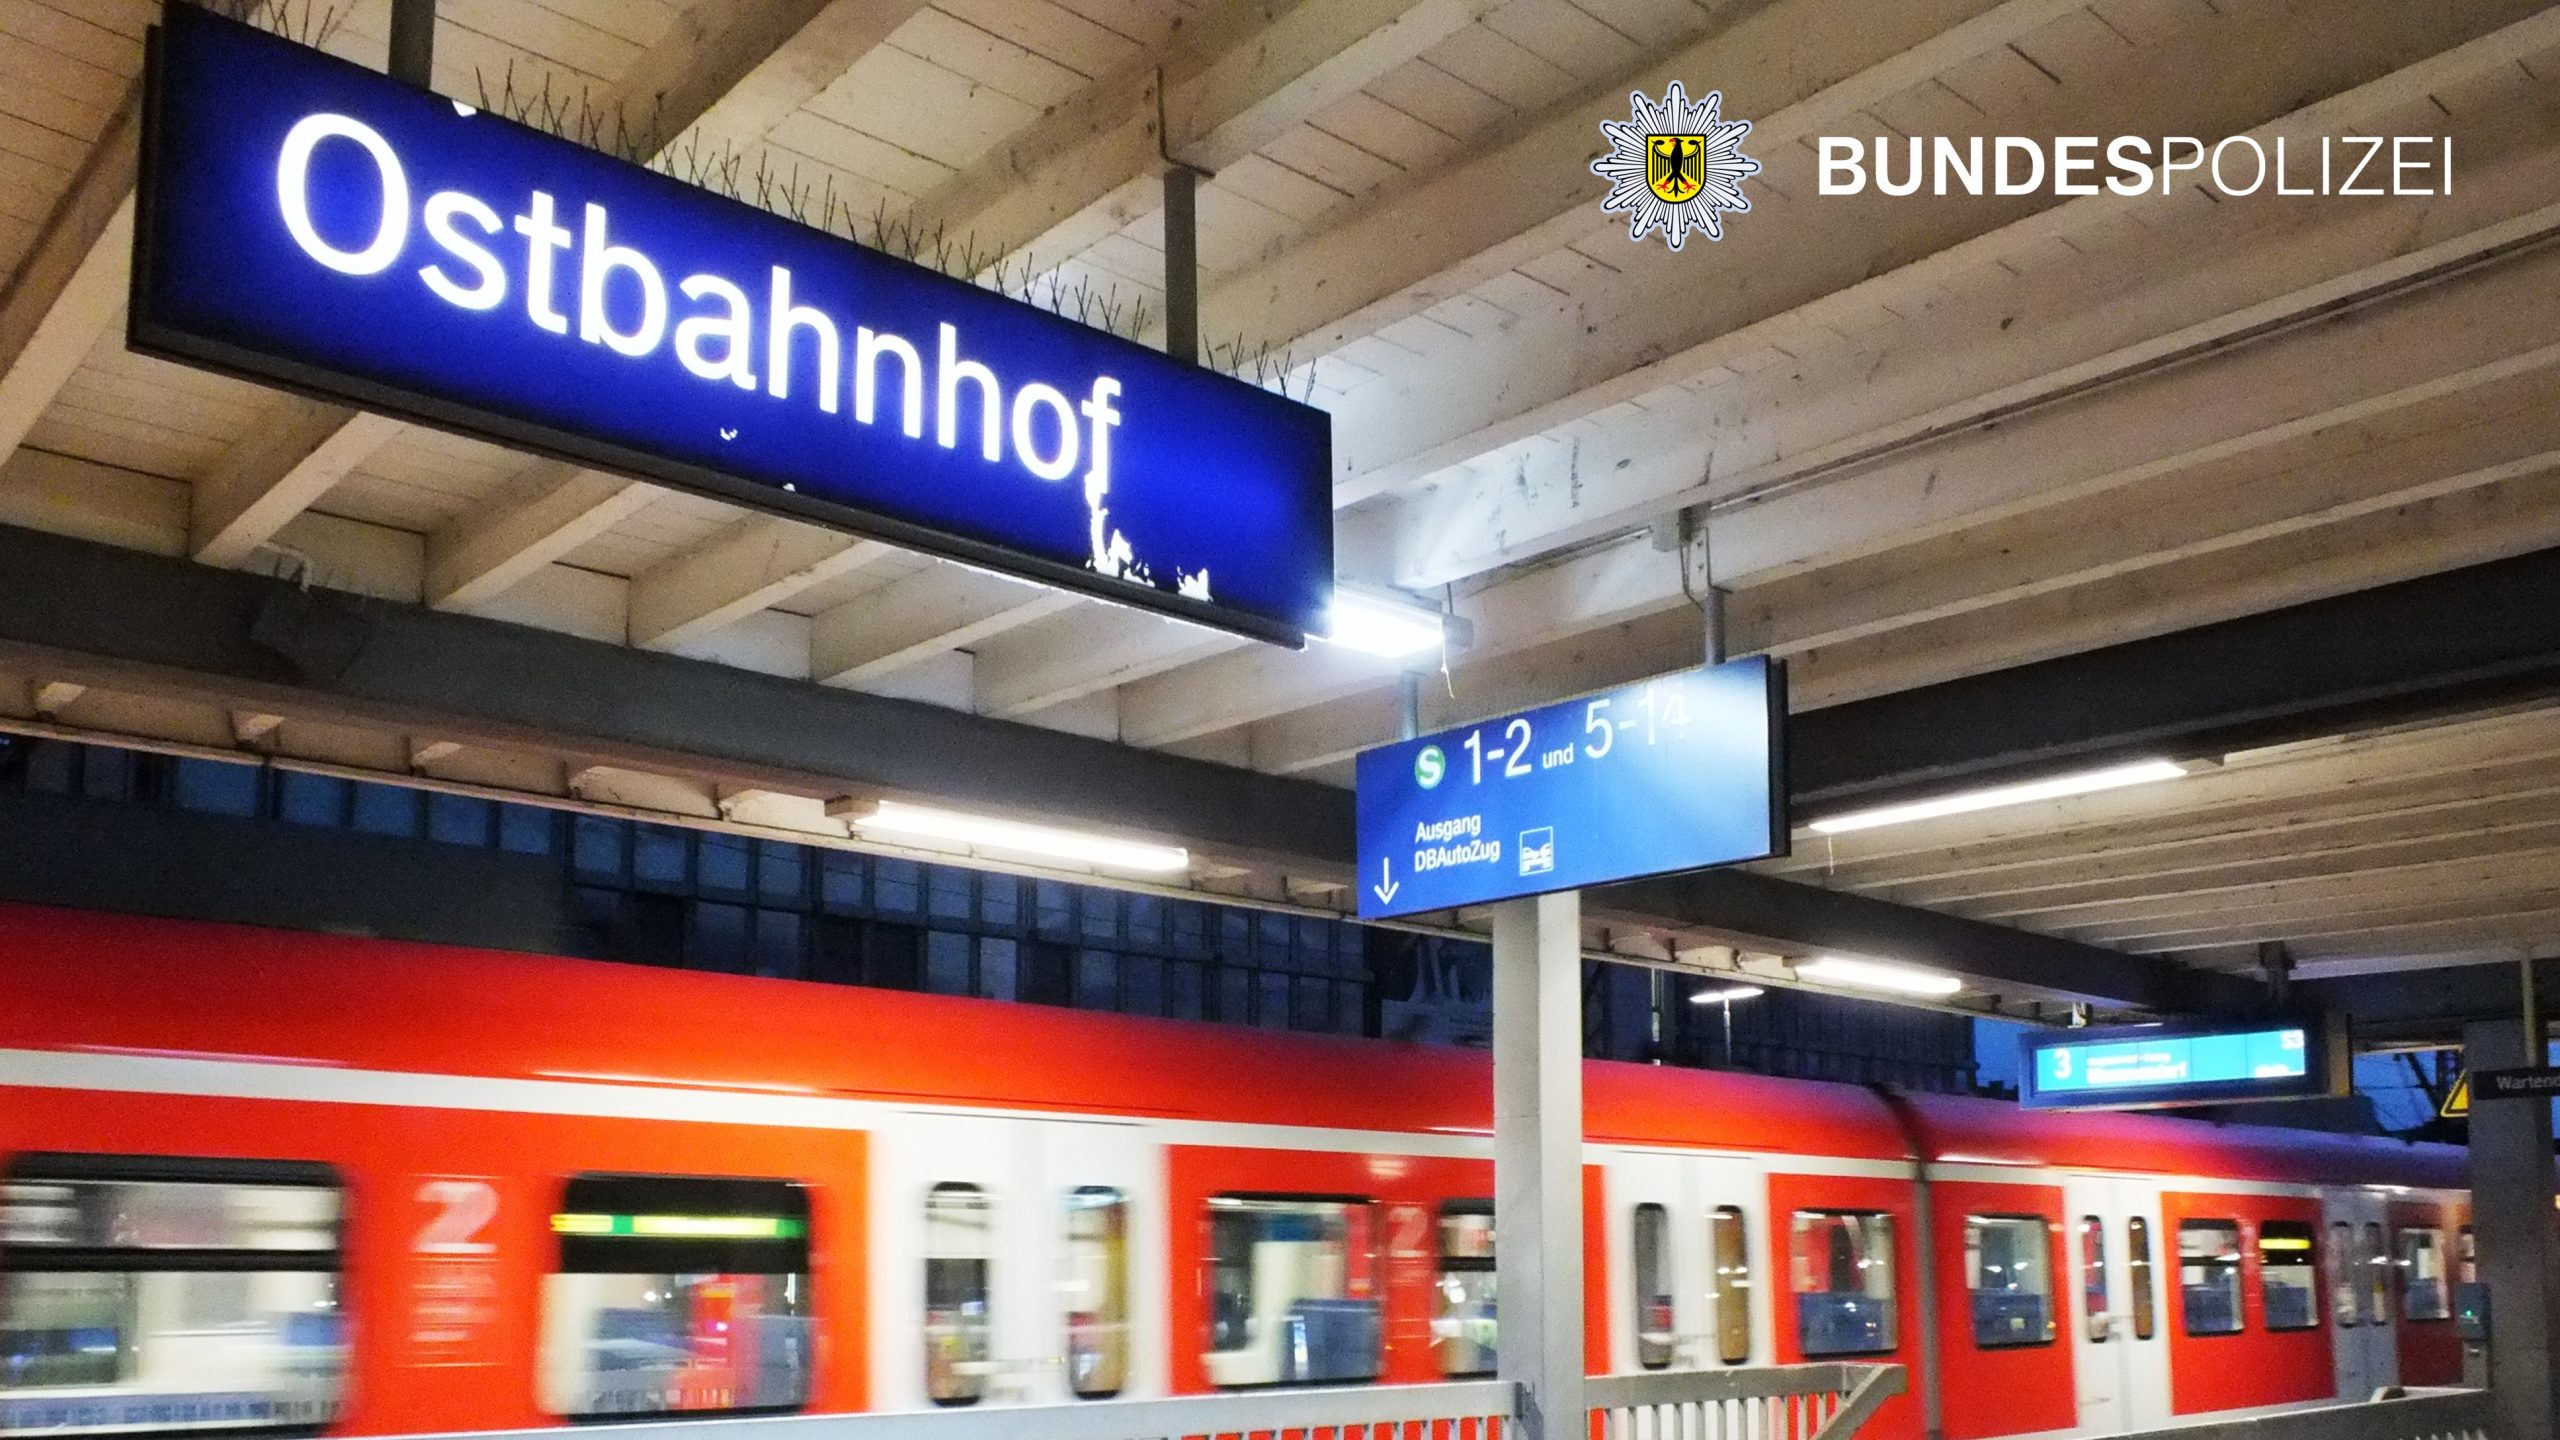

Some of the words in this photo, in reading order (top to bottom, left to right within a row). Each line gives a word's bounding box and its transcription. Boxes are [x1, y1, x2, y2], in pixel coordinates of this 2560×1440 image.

[276, 112, 1122, 495] Ostbahnhof
[1418, 748, 1442, 786] S
[1464, 718, 1532, 785] 1-2
[1542, 742, 1574, 769] und
[1415, 814, 1482, 844] Ausgang
[1414, 839, 1501, 873] DBAutoZug
[2053, 1047, 2073, 1080] 3
[412, 1181, 499, 1254] 2
[1388, 1206, 1428, 1258] 2
